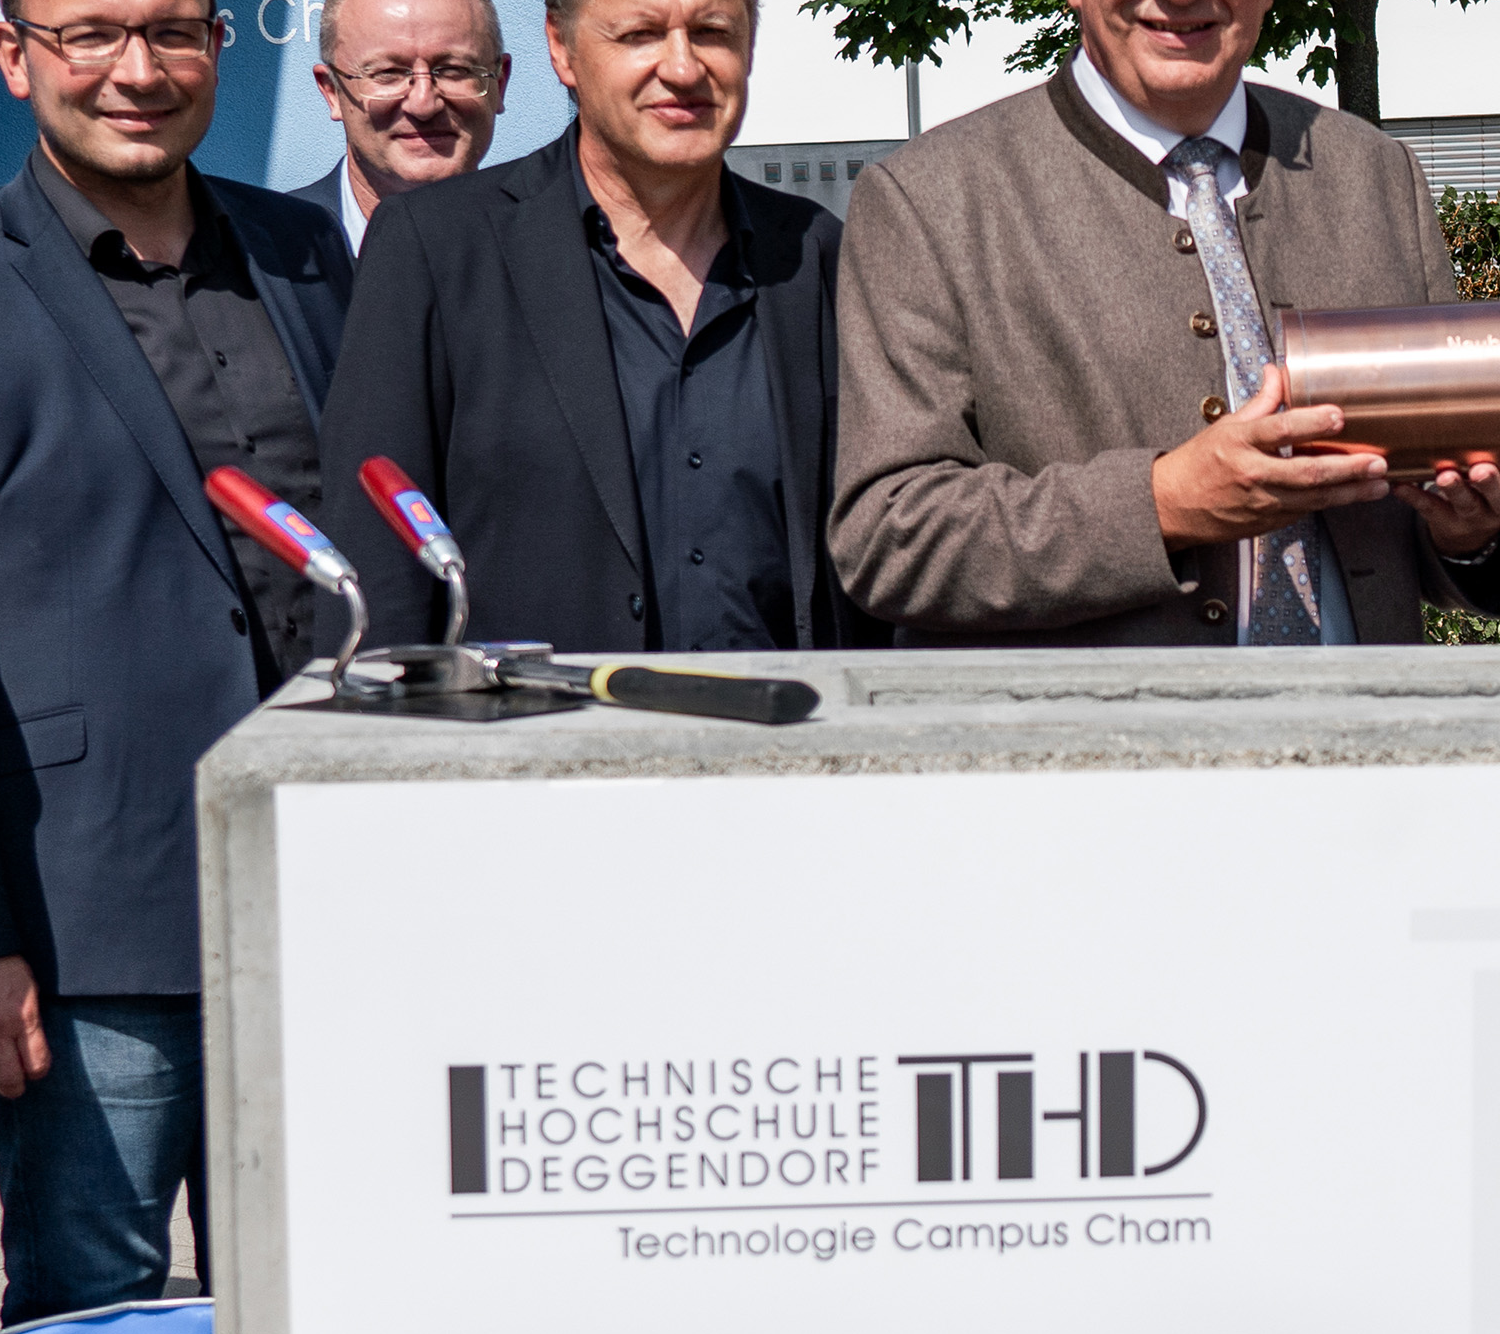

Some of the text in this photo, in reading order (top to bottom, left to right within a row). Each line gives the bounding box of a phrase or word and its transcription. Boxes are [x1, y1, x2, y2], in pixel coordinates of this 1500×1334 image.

[502, 1056, 879, 1101] TECHNISCHE
[500, 1102, 881, 1146] HOCHSCHULE
[501, 1148, 884, 1194] DEGGENDORF
[618, 1212, 1212, 1263] Technologie Campus Cham
